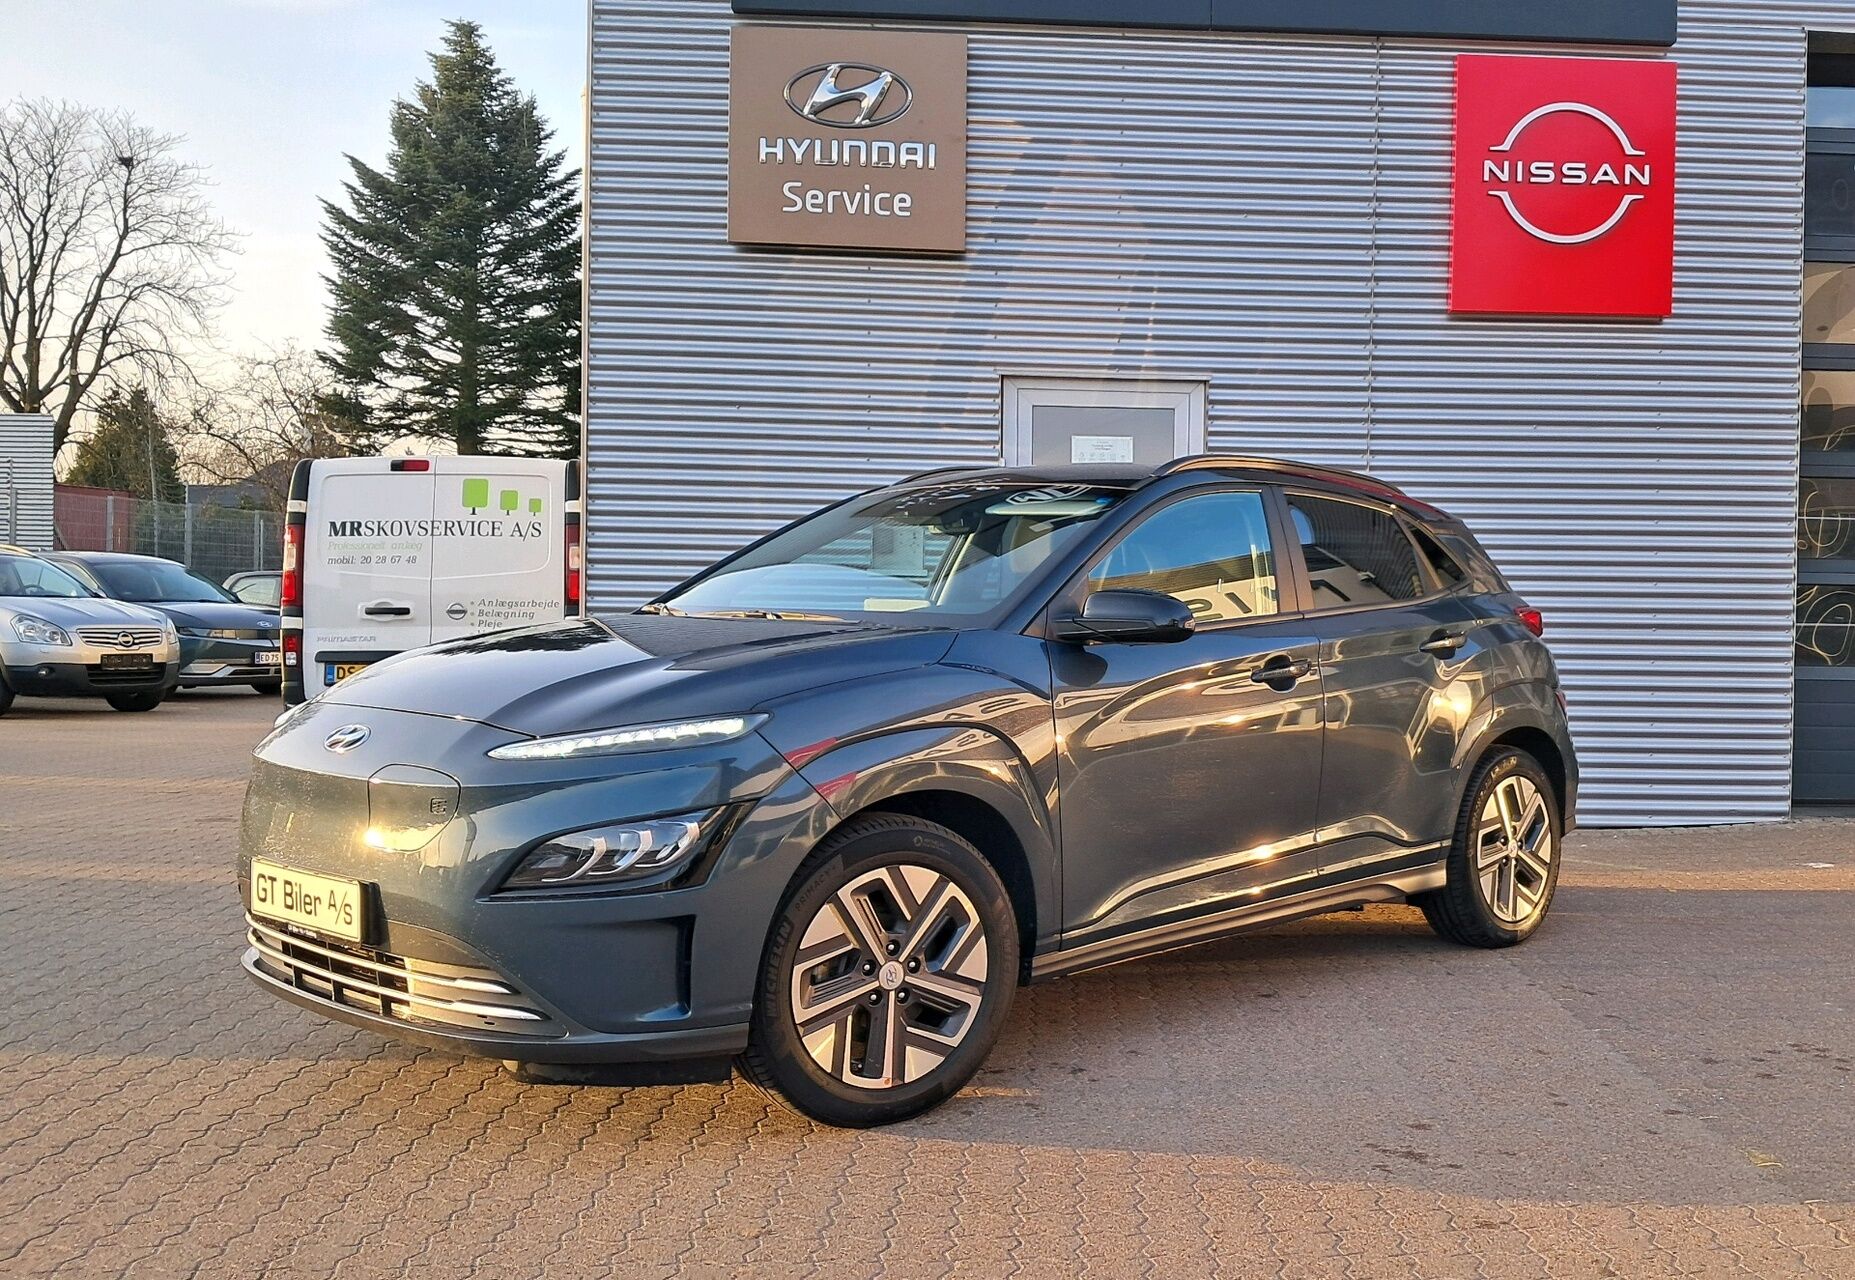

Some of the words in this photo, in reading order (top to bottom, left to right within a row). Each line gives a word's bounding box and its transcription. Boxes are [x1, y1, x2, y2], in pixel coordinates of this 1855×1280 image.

[758, 137, 936, 169] HYUNDAI
[1482, 160, 1650, 185] NISSAN
[782, 181, 912, 217] Service
[510, 520, 542, 541] A/S
[327, 555, 356, 565] mobil:
[360, 555, 372, 565] 20
[375, 555, 387, 565] 28
[390, 555, 402, 565] 67
[405, 555, 417, 565] 48
[477, 598, 560, 609] Anlægsarbejde
[477, 609, 535, 619] Belægning
[477, 619, 503, 629] Pleje
[256, 873, 277, 905] GT
[283, 879, 322, 917] Biler
[328, 889, 353, 926] A/S
